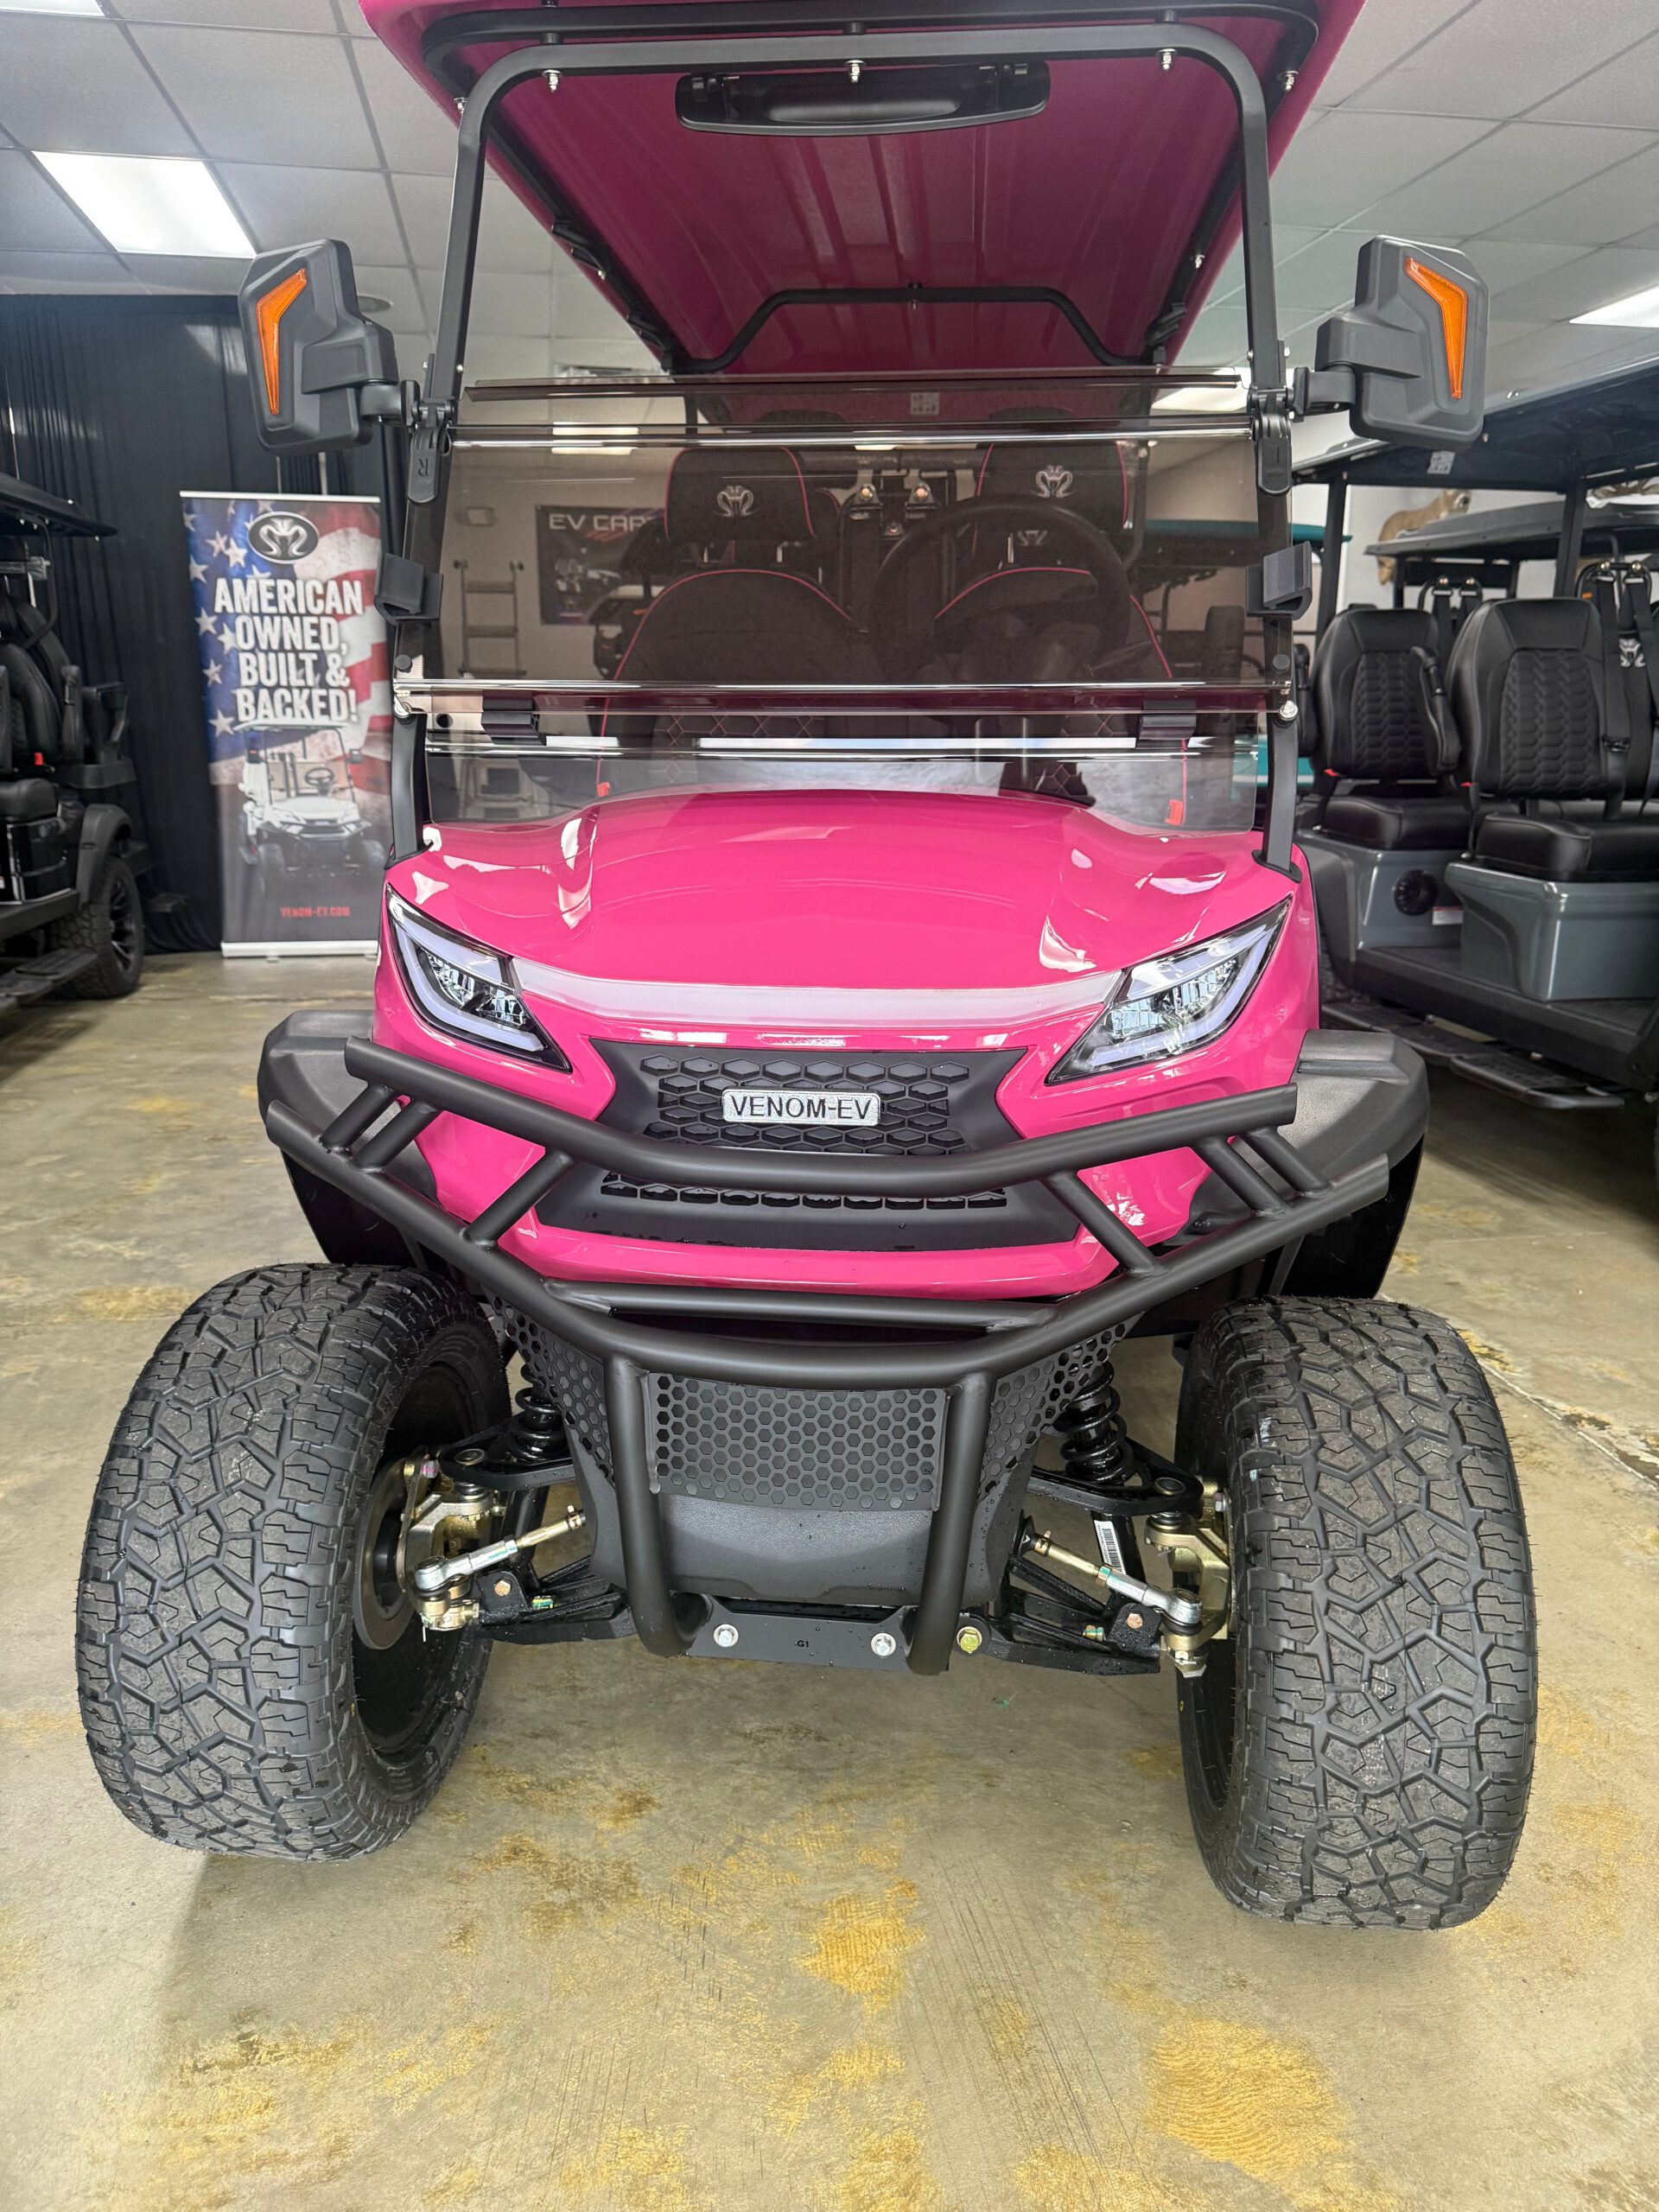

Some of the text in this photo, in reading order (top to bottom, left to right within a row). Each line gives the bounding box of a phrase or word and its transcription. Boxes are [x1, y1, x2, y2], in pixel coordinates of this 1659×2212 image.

[549, 513, 654, 532] EV CAR
[213, 577, 364, 616] AMERICAN
[234, 615, 347, 656] OWNED,
[238, 652, 350, 688] BUILT &
[236, 688, 359, 723] BACKED!
[730, 1094, 872, 1120] VENOM-EV
